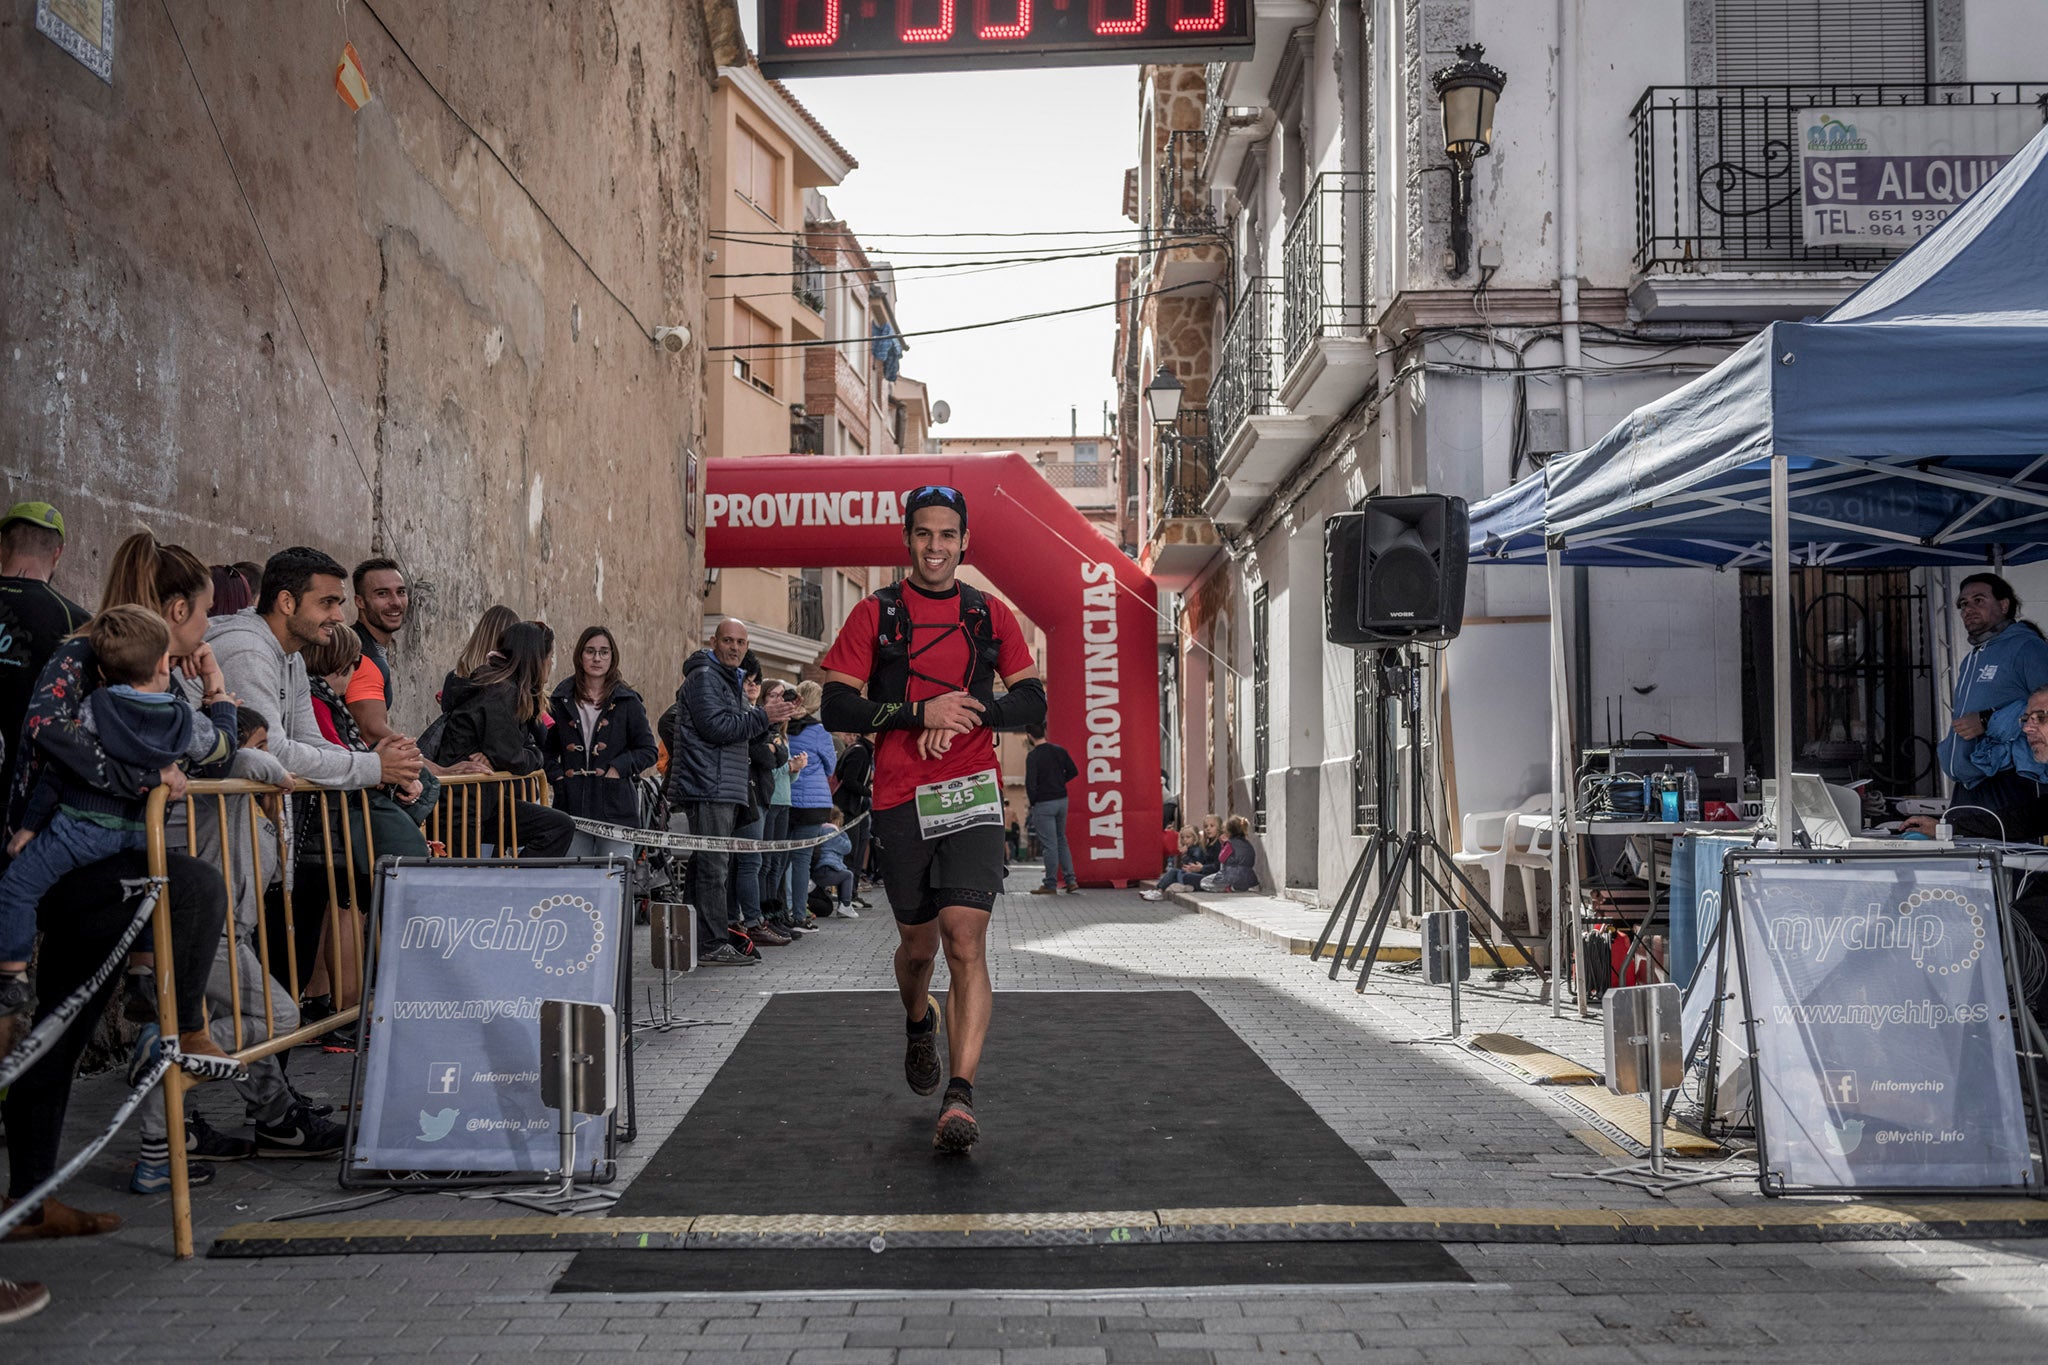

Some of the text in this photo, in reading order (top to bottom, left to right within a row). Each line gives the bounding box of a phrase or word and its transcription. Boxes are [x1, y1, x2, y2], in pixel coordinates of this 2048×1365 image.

[1812, 161, 1857, 200] SE
[1815, 209, 1948, 236] TEL.: 651 930
[1869, 224, 1906, 236] 964
[1081, 561, 1124, 861] LAS PROVINCIAS
[940, 788, 975, 808] 545
[400, 906, 568, 962] mychip
[1768, 903, 1945, 962] mychip
[393, 996, 541, 1024] www.mychi
[1773, 999, 1989, 1030] www.mychip.es
[471, 1070, 539, 1084] /infomychip
[1871, 1080, 1945, 1093] /infomychip
[466, 1118, 550, 1132] @Mychip_Info
[1875, 1130, 1965, 1145] @Mychip_Info
